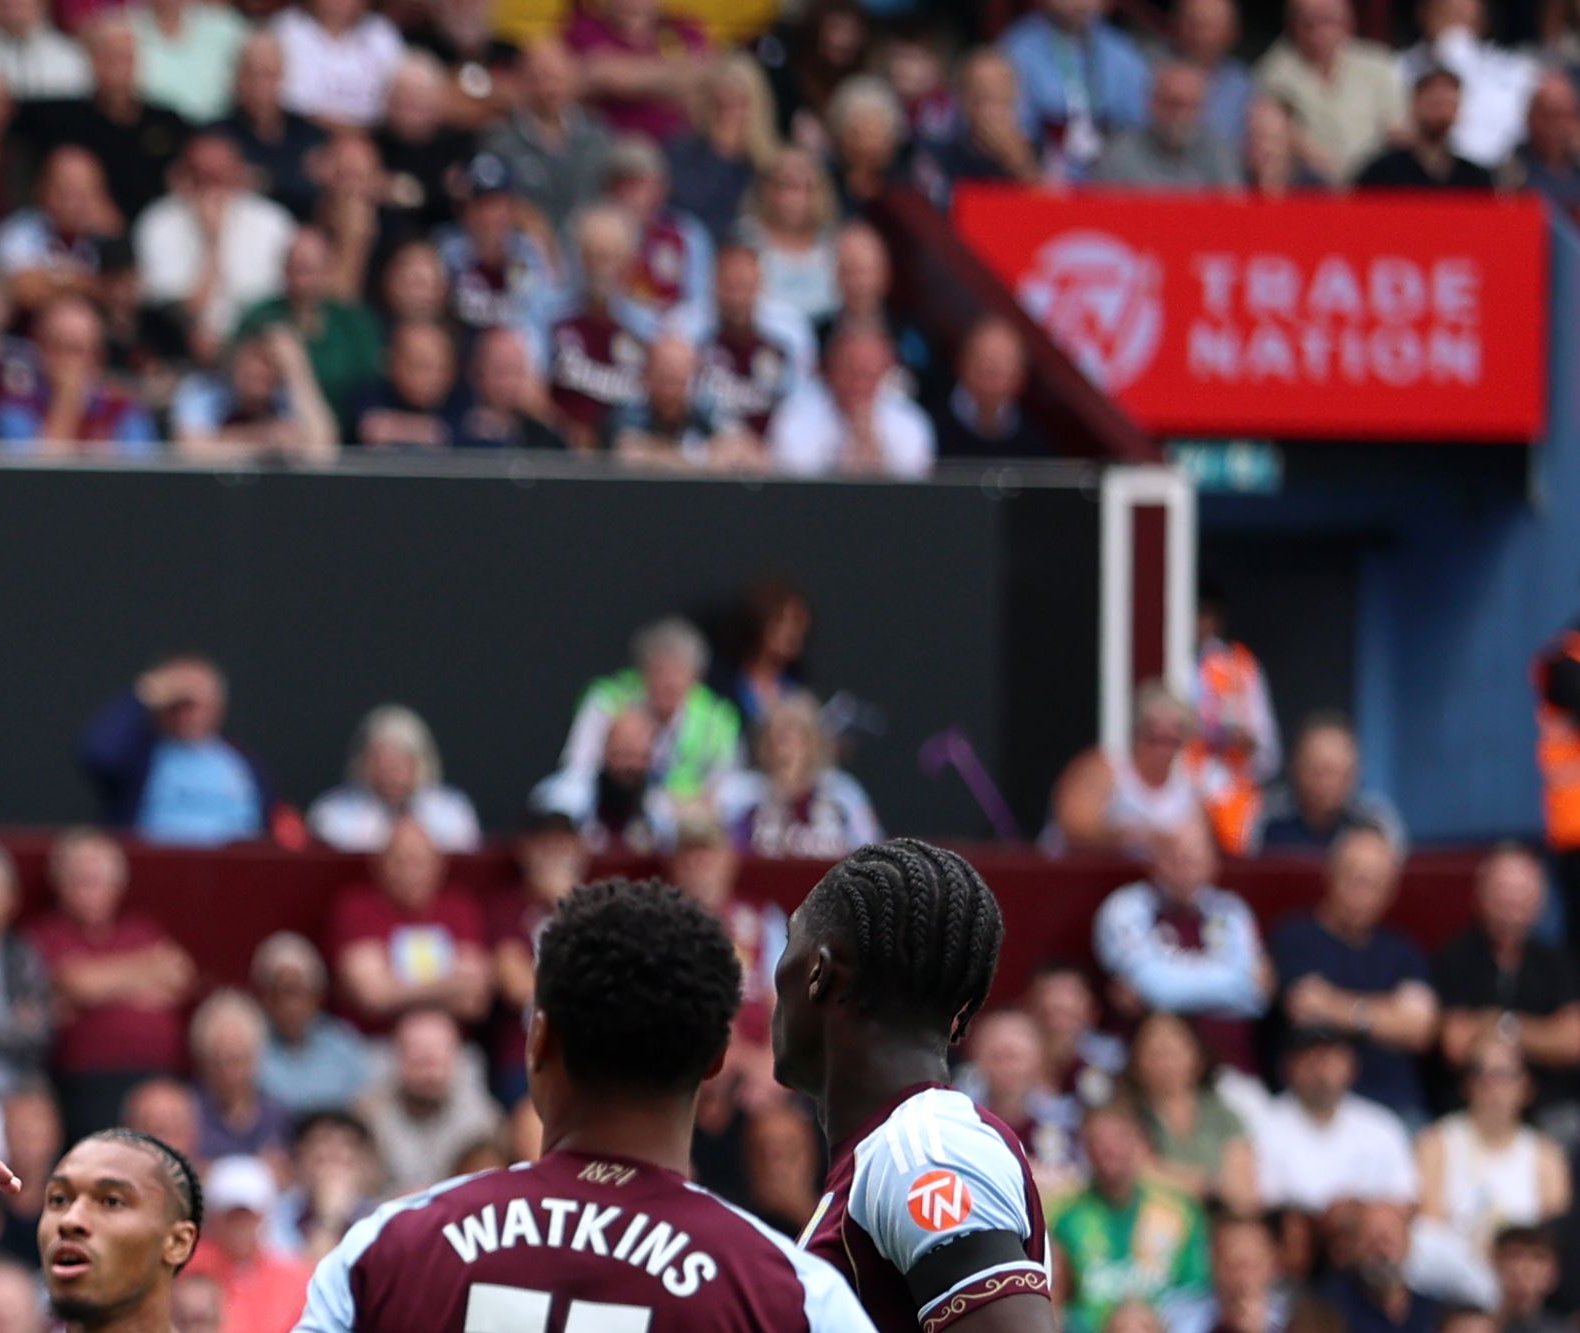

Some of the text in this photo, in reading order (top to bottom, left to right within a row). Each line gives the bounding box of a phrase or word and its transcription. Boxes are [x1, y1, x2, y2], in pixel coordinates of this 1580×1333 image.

[1189, 255, 1481, 322] TRADE
[1187, 322, 1483, 384] NATION
[441, 1197, 718, 1298] WATKINS
